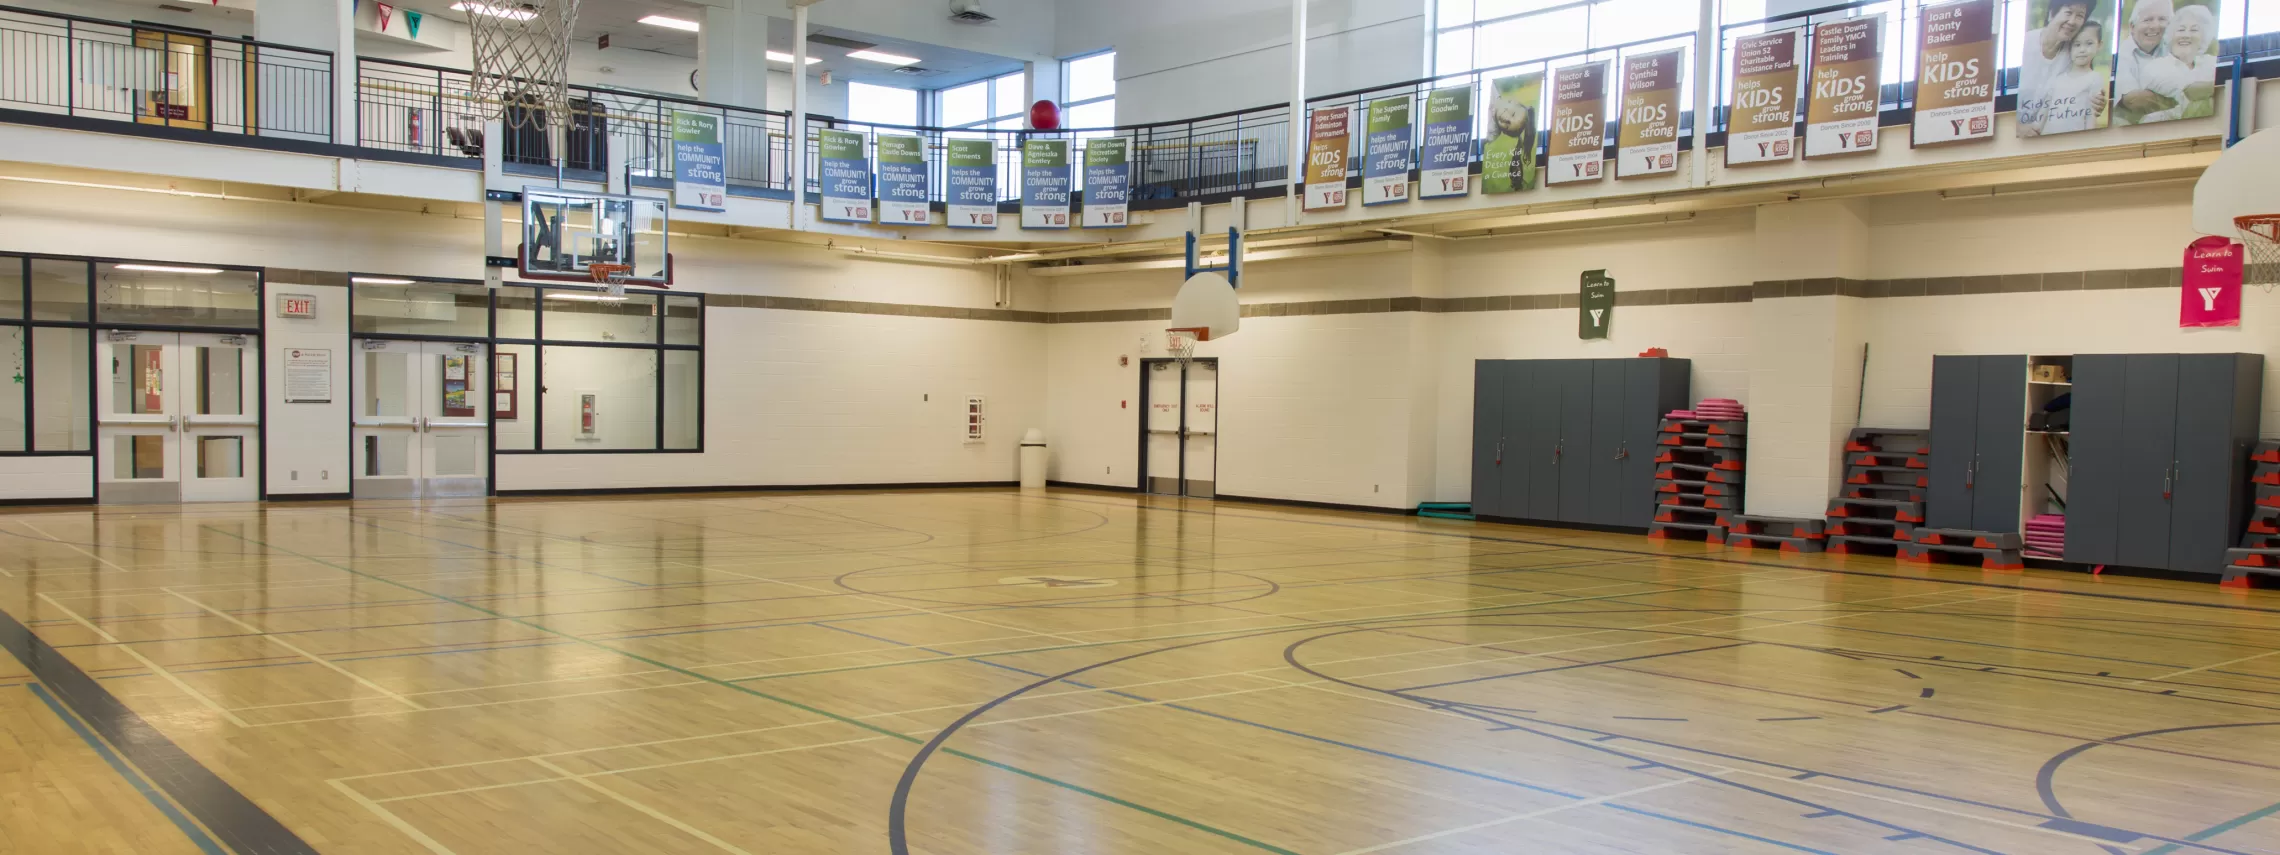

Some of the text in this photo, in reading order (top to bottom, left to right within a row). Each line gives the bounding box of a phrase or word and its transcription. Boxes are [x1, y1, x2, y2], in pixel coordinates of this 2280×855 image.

[1928, 8, 1962, 22] Joan &
[1821, 24, 1867, 36] Castle Downs
[1928, 21, 1961, 32] Monty
[1759, 38, 1782, 46] Service
[1821, 32, 1866, 45] Family YMCA
[1928, 33, 1956, 44] Baker
[1820, 45, 1848, 53] Leaders
[1741, 56, 1774, 66] Charitable
[1820, 53, 1848, 62] Training
[1927, 52, 1948, 62] help
[1631, 62, 1650, 70] Peter
[1740, 60, 1790, 74] Assistance Fund
[1924, 58, 1979, 84] KIDS
[1560, 72, 1582, 81] Hector
[1630, 69, 1657, 80] Cynthia
[1818, 69, 1838, 79] help
[1559, 82, 1580, 91] Louisa
[1629, 80, 1654, 90] Wilson
[1738, 80, 1760, 90] helps
[1816, 76, 1866, 99] KIDS
[1956, 78, 1977, 89] grow
[1558, 91, 1583, 100] Pothier
[1944, 84, 1989, 99] strong
[1628, 96, 1644, 106] help
[1736, 87, 1782, 110] KIDS
[1844, 94, 1863, 104] grow
[2022, 97, 2076, 109] Kids are
[1431, 104, 1458, 113] Goodwin
[1762, 105, 1780, 114] grow
[1833, 100, 1873, 113] strong
[1330, 111, 1347, 119] Smash
[1557, 107, 1572, 117] help
[1626, 104, 1666, 125] KIDS
[1752, 110, 1790, 124] strong
[2021, 107, 2092, 124] Our Future
[1372, 115, 1390, 123] Family
[1556, 114, 1593, 133] KIDS
[699, 121, 714, 130] Rory
[1429, 126, 1446, 135] helps
[1649, 121, 1665, 130] grow
[1577, 130, 1592, 138] grow
[1640, 126, 1674, 138] strong
[845, 137, 859, 146] Rory
[1371, 136, 1386, 144] helps
[1428, 132, 1469, 146] COMMUNITY
[1568, 135, 1599, 147] strong
[678, 144, 692, 153] help
[1370, 140, 1408, 155] COMMUNITY
[1443, 145, 1458, 153] grow
[678, 153, 720, 165] COMMUNITY
[1311, 150, 1340, 166] KIDS
[1434, 151, 1466, 162] strong
[1486, 148, 1522, 160] Every Kid
[1376, 159, 1406, 170] strong
[688, 169, 721, 182] strong
[825, 168, 866, 179] COMMUNITY
[883, 173, 924, 182] COMMUNITY
[1321, 168, 1344, 177] strong
[952, 177, 993, 186] COMMUNITY
[1027, 178, 1067, 186] COMMUNITY
[1089, 175, 1126, 184] COMMUNITY
[834, 184, 866, 195] strong
[892, 188, 924, 198] strong
[960, 192, 993, 202] strong
[1035, 192, 1066, 202] strong
[1096, 190, 1124, 200] strong
[2201, 264, 2223, 273] Swim
[2198, 287, 2222, 311] Y
[287, 300, 309, 313] EXIT
